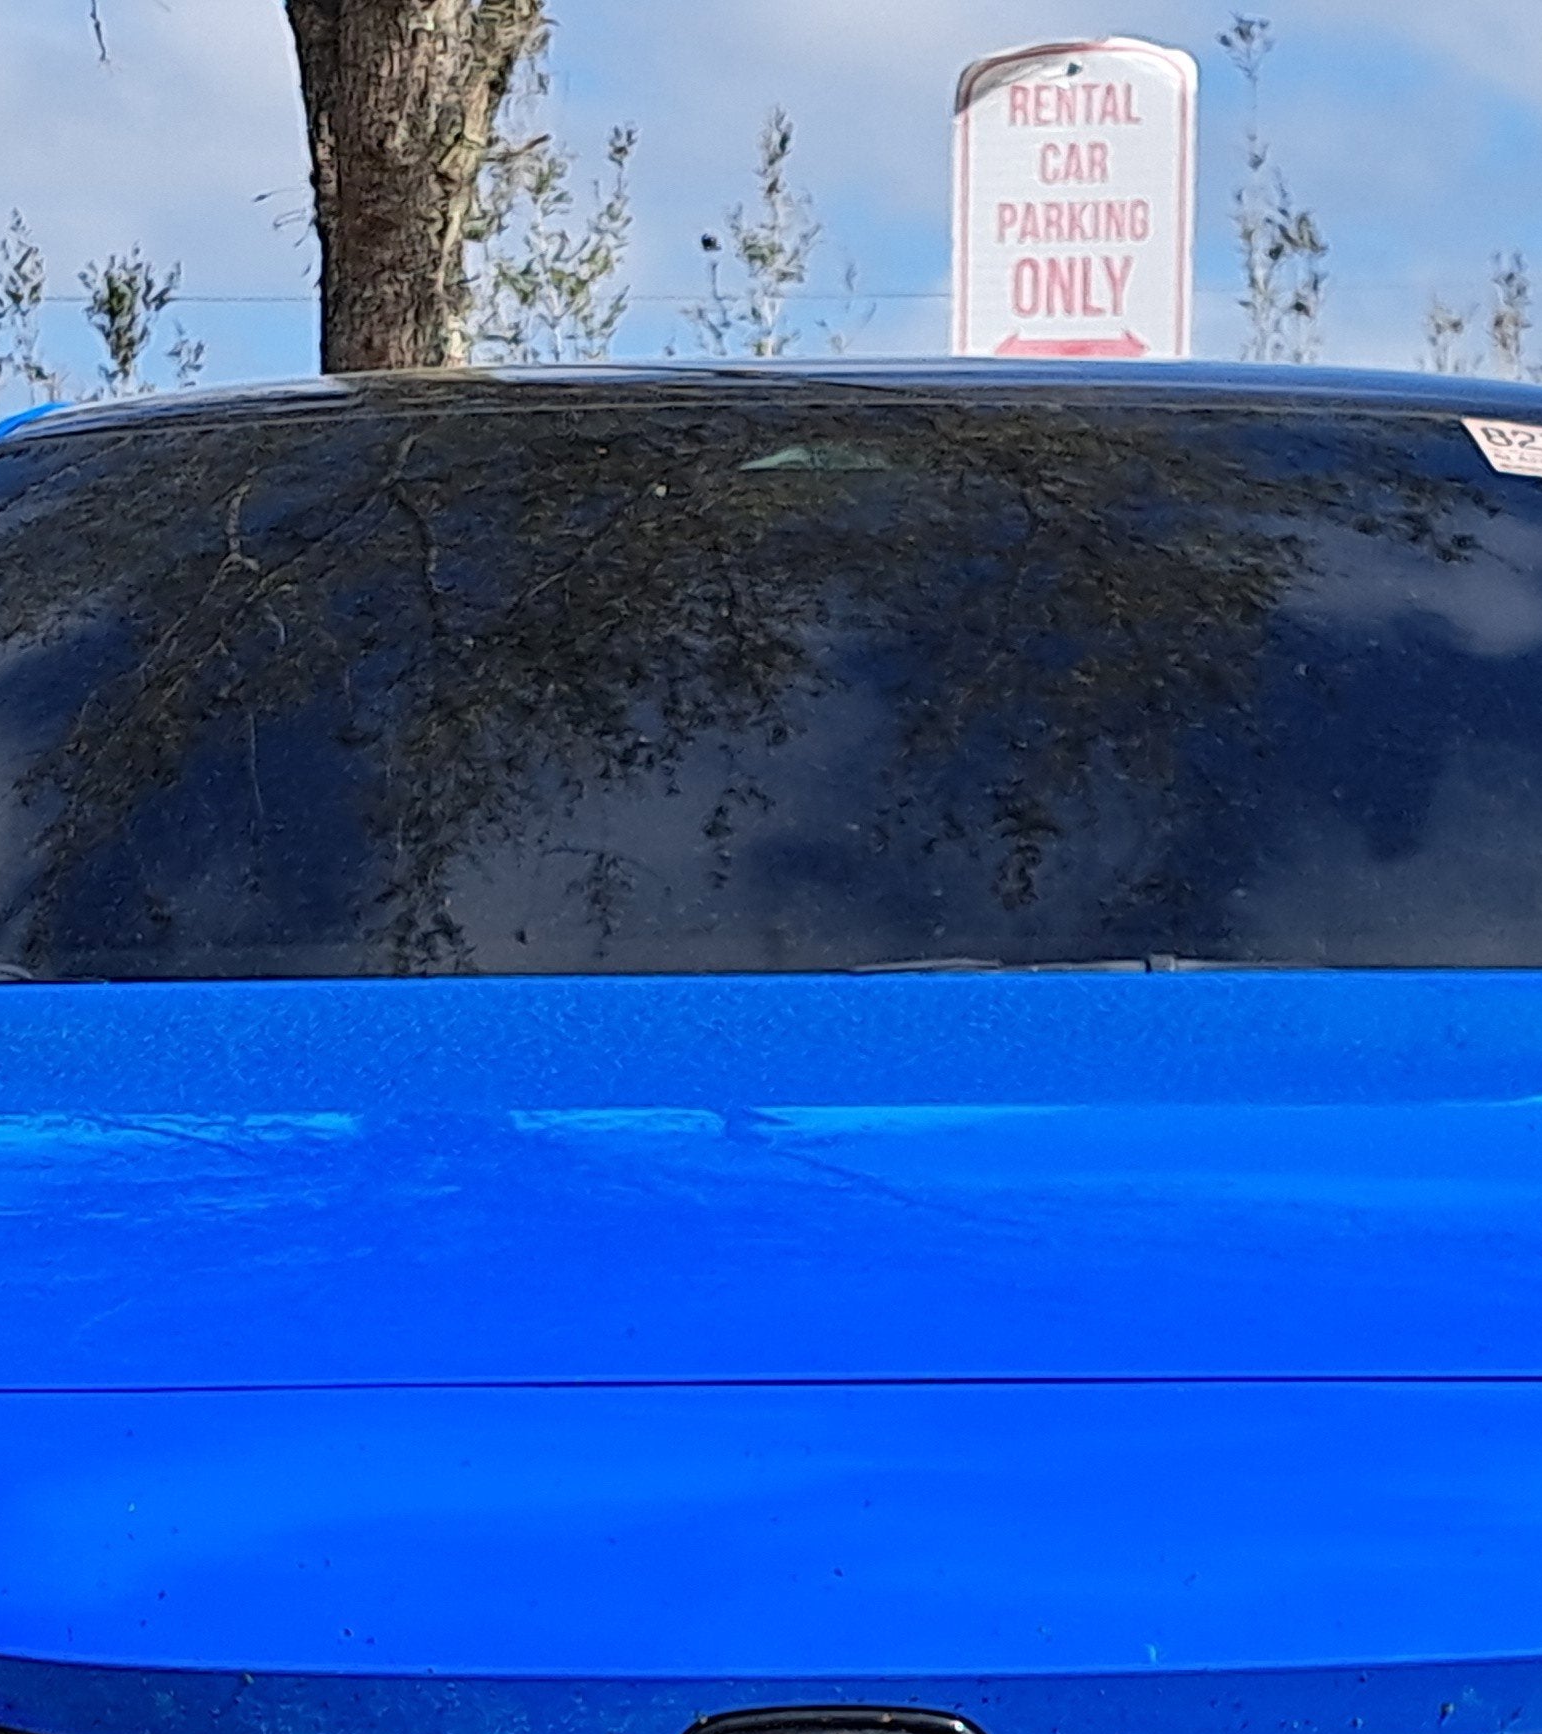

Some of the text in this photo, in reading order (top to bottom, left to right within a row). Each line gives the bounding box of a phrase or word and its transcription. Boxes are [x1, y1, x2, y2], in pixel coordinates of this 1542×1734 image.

[1009, 83, 1142, 126] RENTAL
[1039, 142, 1109, 184] CAR
[996, 199, 1150, 243] PARKING
[1011, 256, 1134, 318] ONLY
